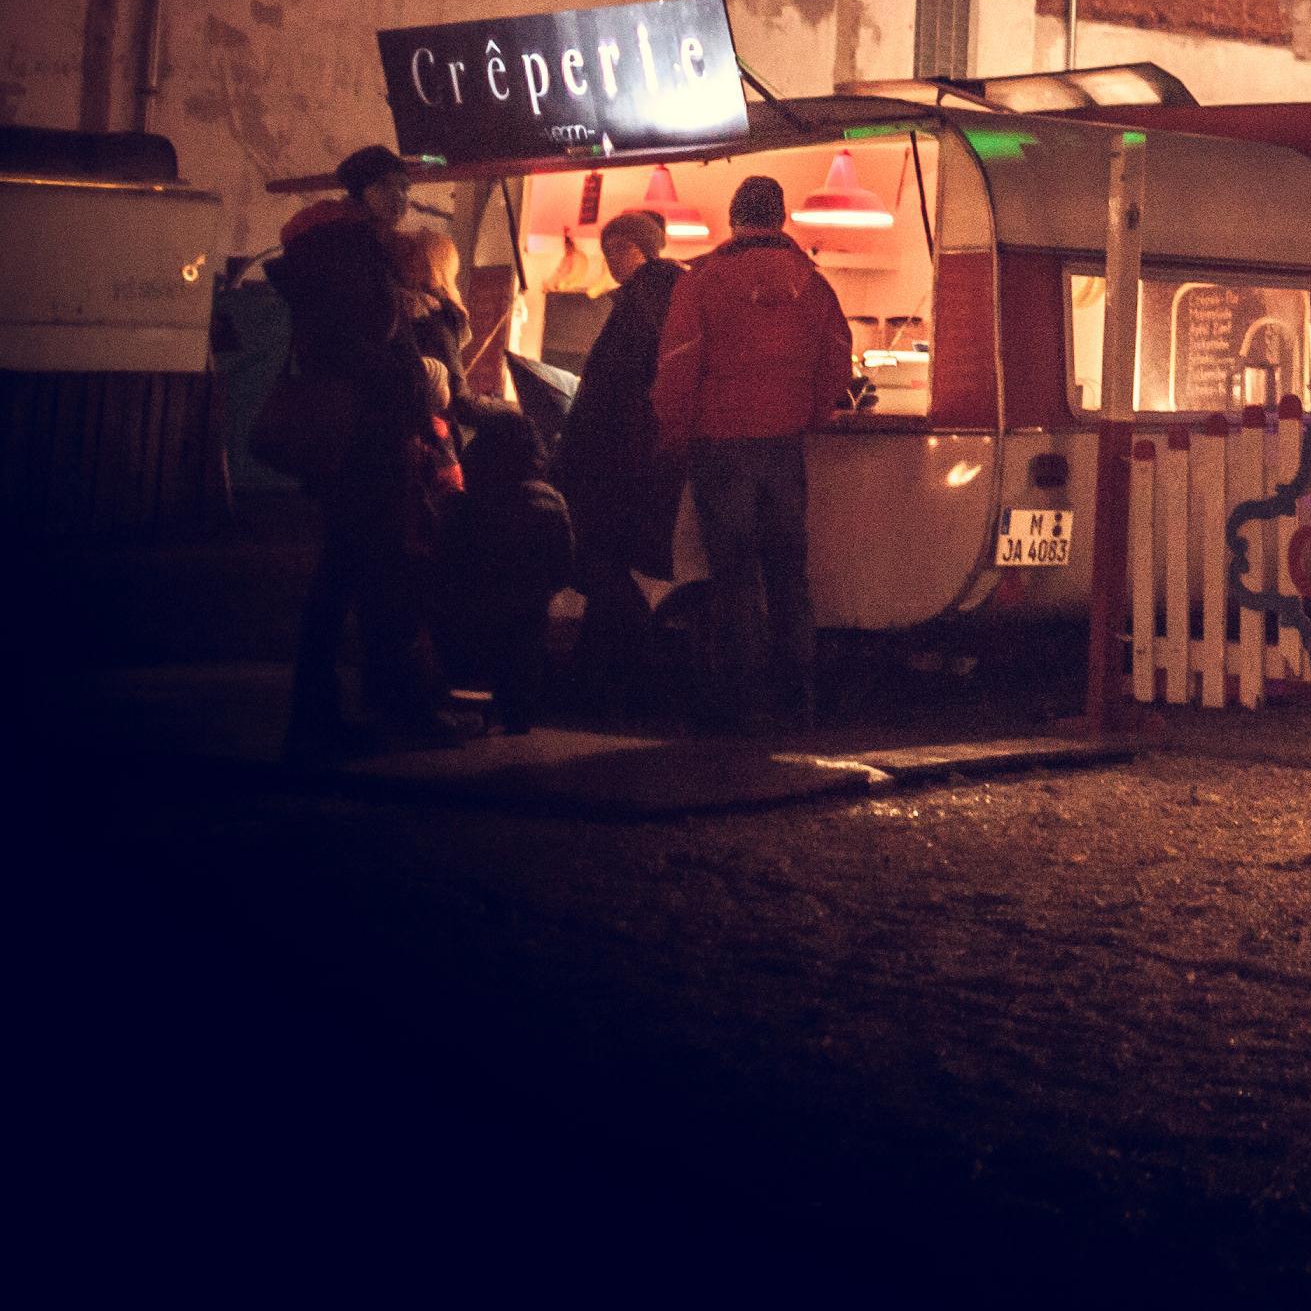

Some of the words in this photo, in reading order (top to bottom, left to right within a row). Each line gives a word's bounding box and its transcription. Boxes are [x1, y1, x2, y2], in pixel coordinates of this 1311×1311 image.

[410, 22, 707, 116] Crêperie
[1002, 538, 1022, 562] JA
[1027, 538, 1068, 563] 4083
